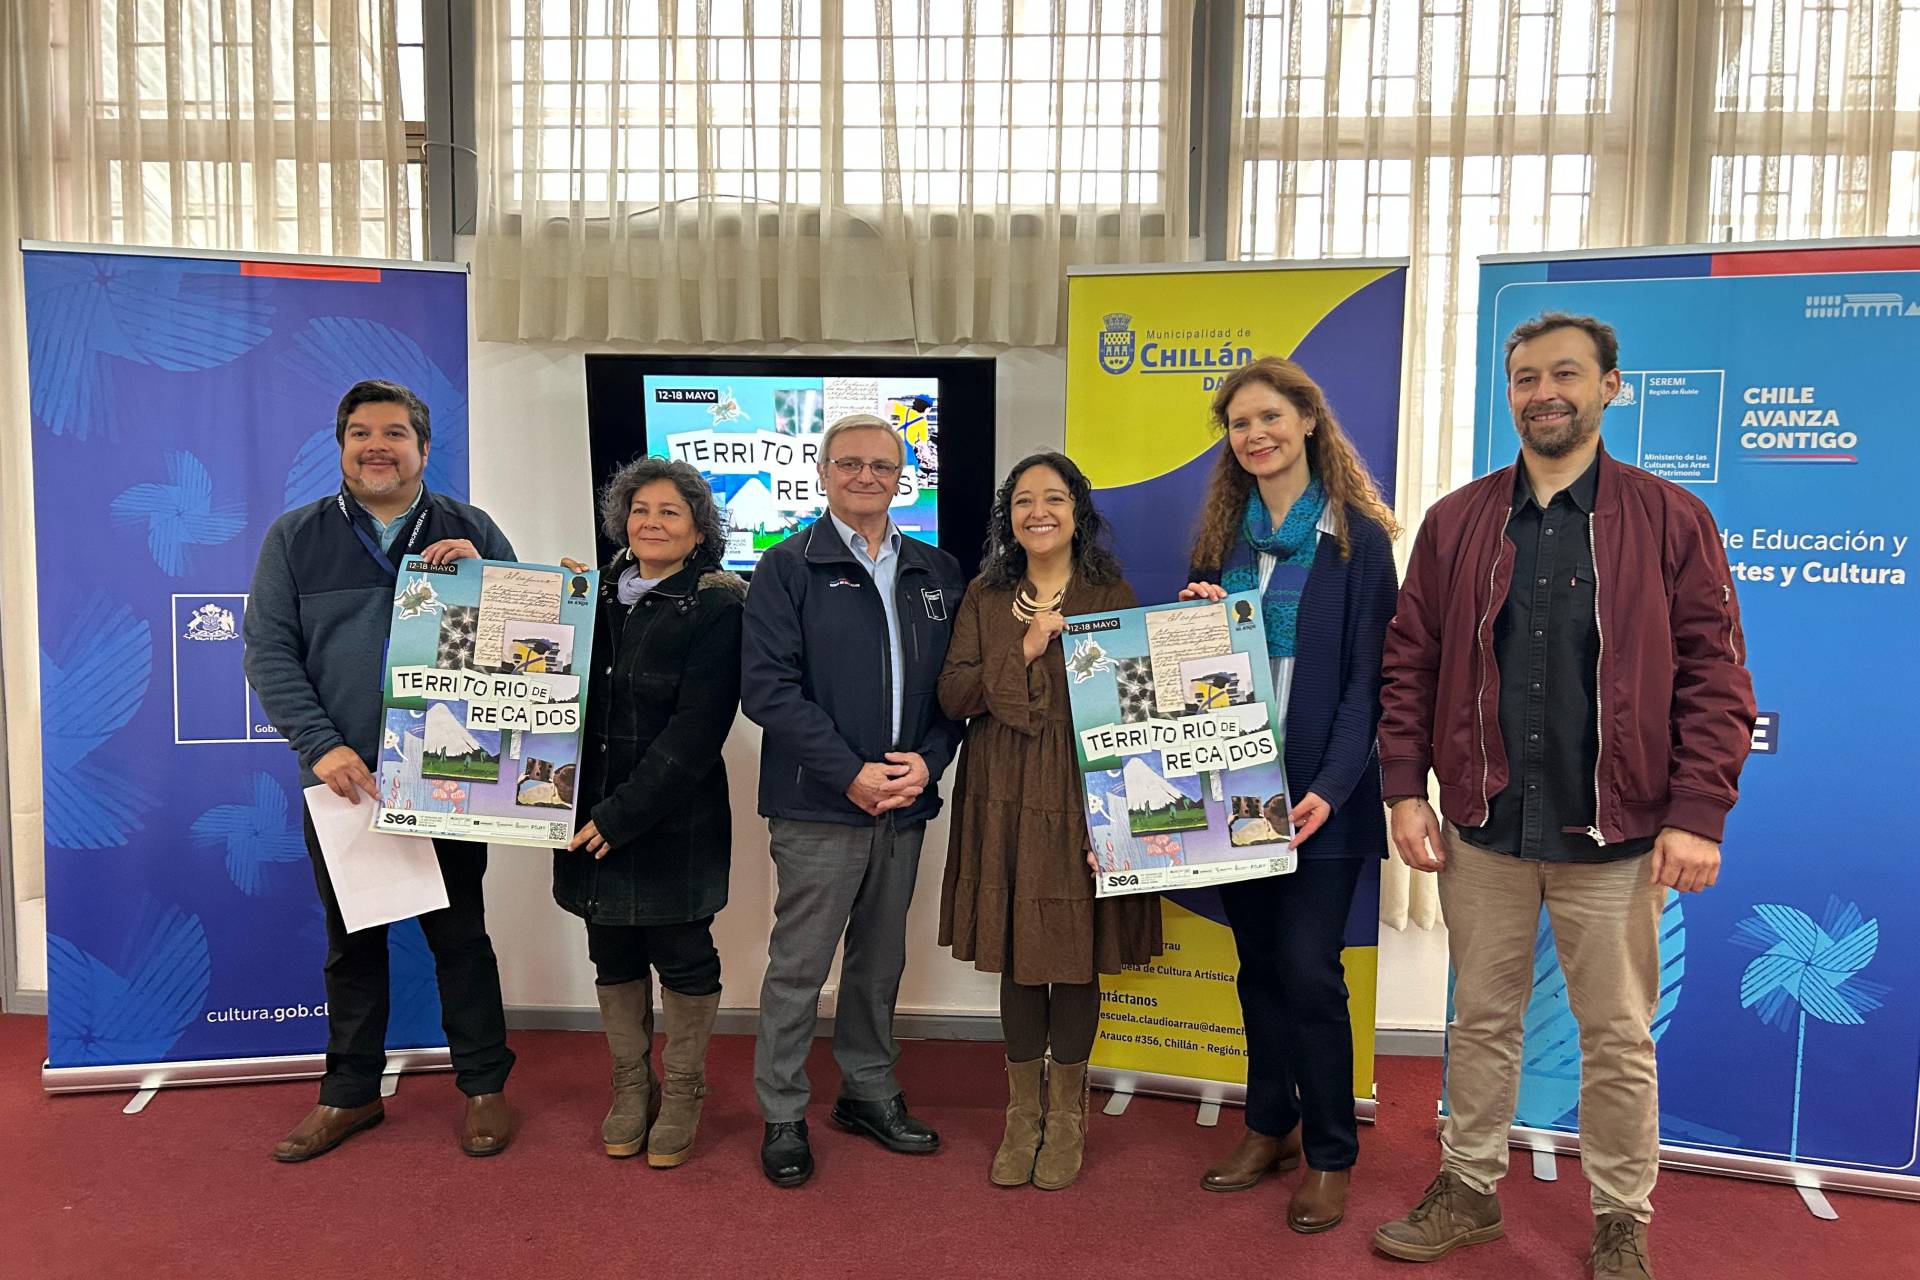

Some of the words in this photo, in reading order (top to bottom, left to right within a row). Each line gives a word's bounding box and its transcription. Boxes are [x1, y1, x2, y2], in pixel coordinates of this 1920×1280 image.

[1146, 328, 1231, 341] Municipalidad
[1237, 328, 1250, 337] de
[1649, 377, 1686, 386] SEREMI
[657, 389, 683, 400] 12-18
[685, 390, 716, 401] MAYO
[1744, 387, 1815, 404] CHILE
[1741, 410, 1840, 426] AVANZA
[1741, 432, 1857, 449] CONTIGO
[676, 440, 817, 465] TERRITOR
[1752, 529, 1884, 551] Educación
[1891, 536, 1908, 557] y
[409, 562, 428, 570] 12-18
[430, 564, 456, 572] MAYO
[1729, 562, 1774, 581] rtes
[1780, 566, 1797, 587] y
[1802, 561, 1906, 585] Cultura
[1070, 623, 1091, 632] 12-18
[1093, 620, 1118, 630] MAYO
[532, 686, 548, 698] DE
[472, 706, 577, 726] RECADOS
[1221, 722, 1236, 732] DE
[1167, 737, 1273, 770] RECADOS
[383, 813, 417, 825] sea
[1108, 874, 1139, 887] sea
[1121, 963, 1141, 971] uela
[1143, 964, 1155, 973] de
[1157, 965, 1191, 977] Cultura
[1195, 969, 1234, 982] Artística
[1100, 990, 1158, 1007] ntáctanos
[207, 1002, 329, 1022] cultura.gob.cl
[1100, 1011, 1245, 1035] escuela.claudioarrau@daemch
[1100, 1031, 1132, 1042] Arauco
[1135, 1035, 1162, 1047] #356,
[1164, 1038, 1198, 1051] Chillán
[1207, 1043, 1240, 1056] Región
